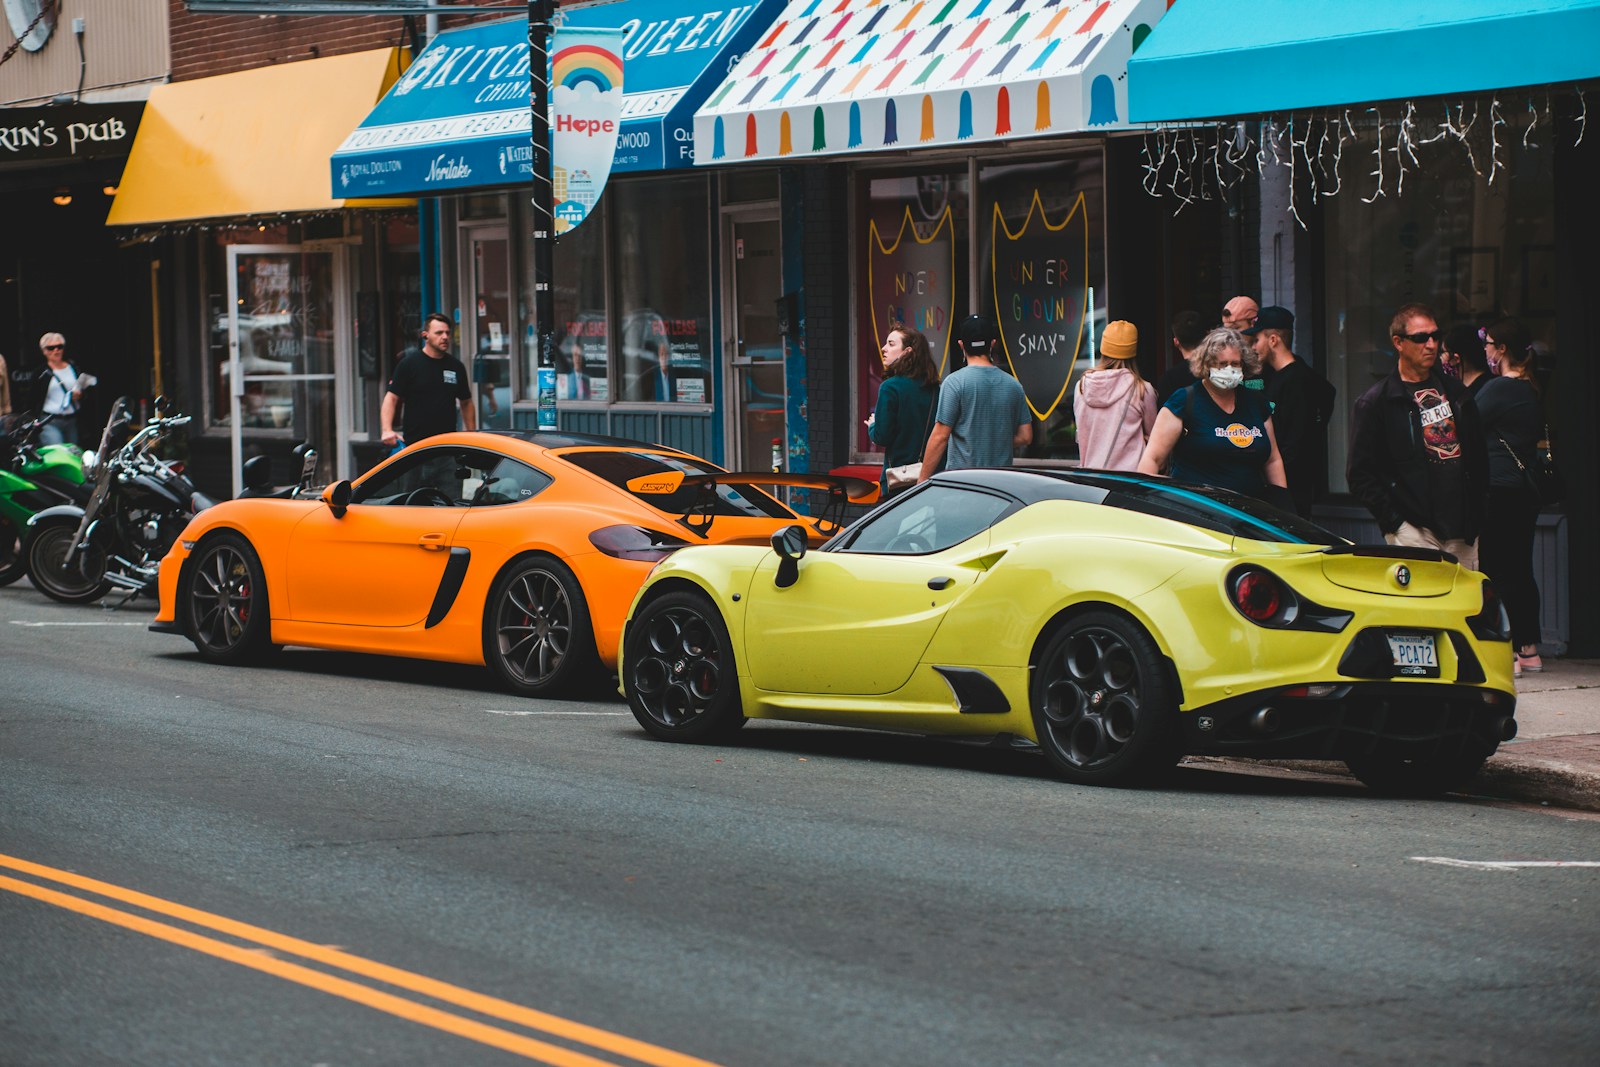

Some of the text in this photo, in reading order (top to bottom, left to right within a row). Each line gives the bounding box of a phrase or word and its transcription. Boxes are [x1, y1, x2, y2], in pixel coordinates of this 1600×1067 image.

[421, 43, 532, 90] KITCH
[474, 80, 532, 104] CHINA
[393, 123, 458, 142] BRIDAL
[616, 131, 650, 149] GWOOD
[505, 145, 533, 163] WATER
[652, 319, 697, 336] FOR LEASE
[1214, 425, 1263, 438] Hard Rock
[1399, 645, 1433, 664] PCA72
